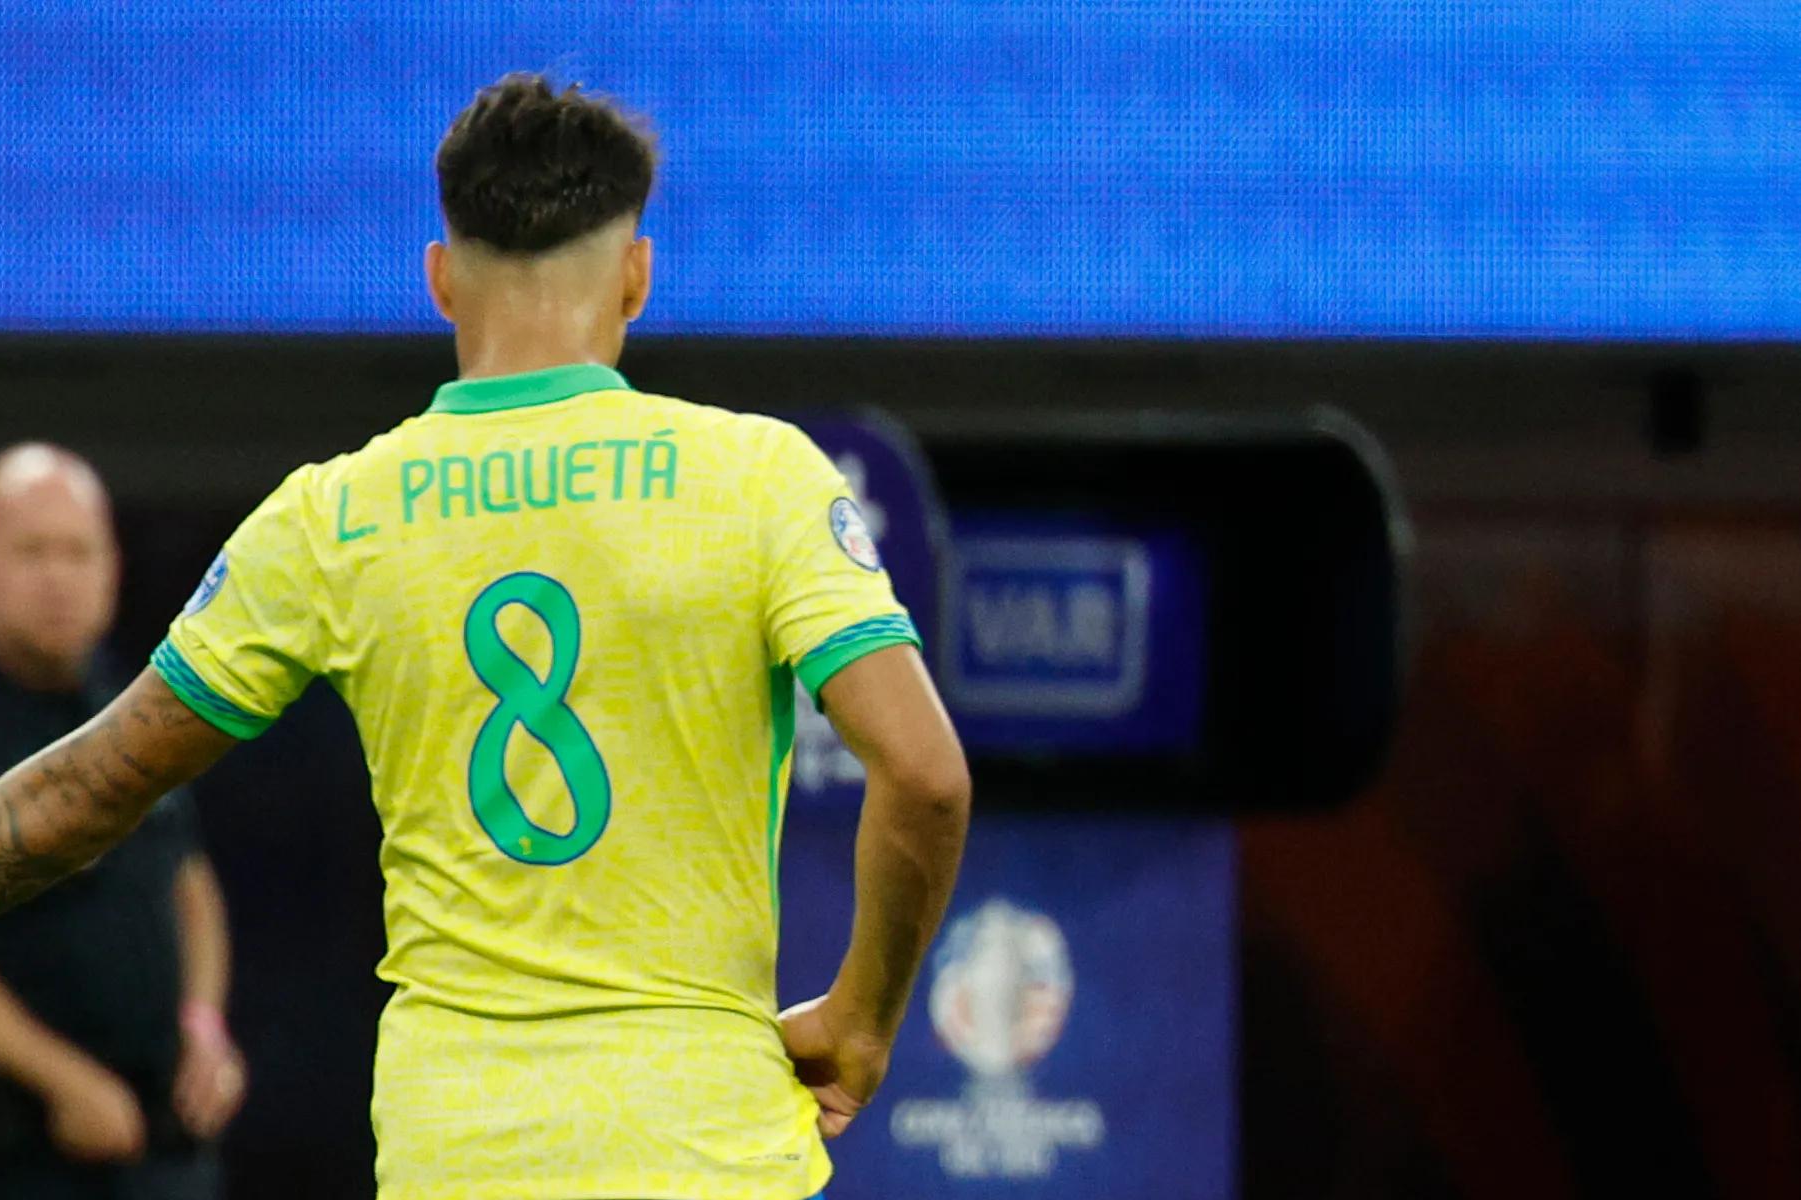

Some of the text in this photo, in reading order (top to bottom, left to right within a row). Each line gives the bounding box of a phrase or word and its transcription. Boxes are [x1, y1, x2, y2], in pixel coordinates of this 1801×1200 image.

[401, 429, 678, 524] PAQUETÁ
[965, 578, 1119, 666] VAR
[463, 571, 612, 866] 8
